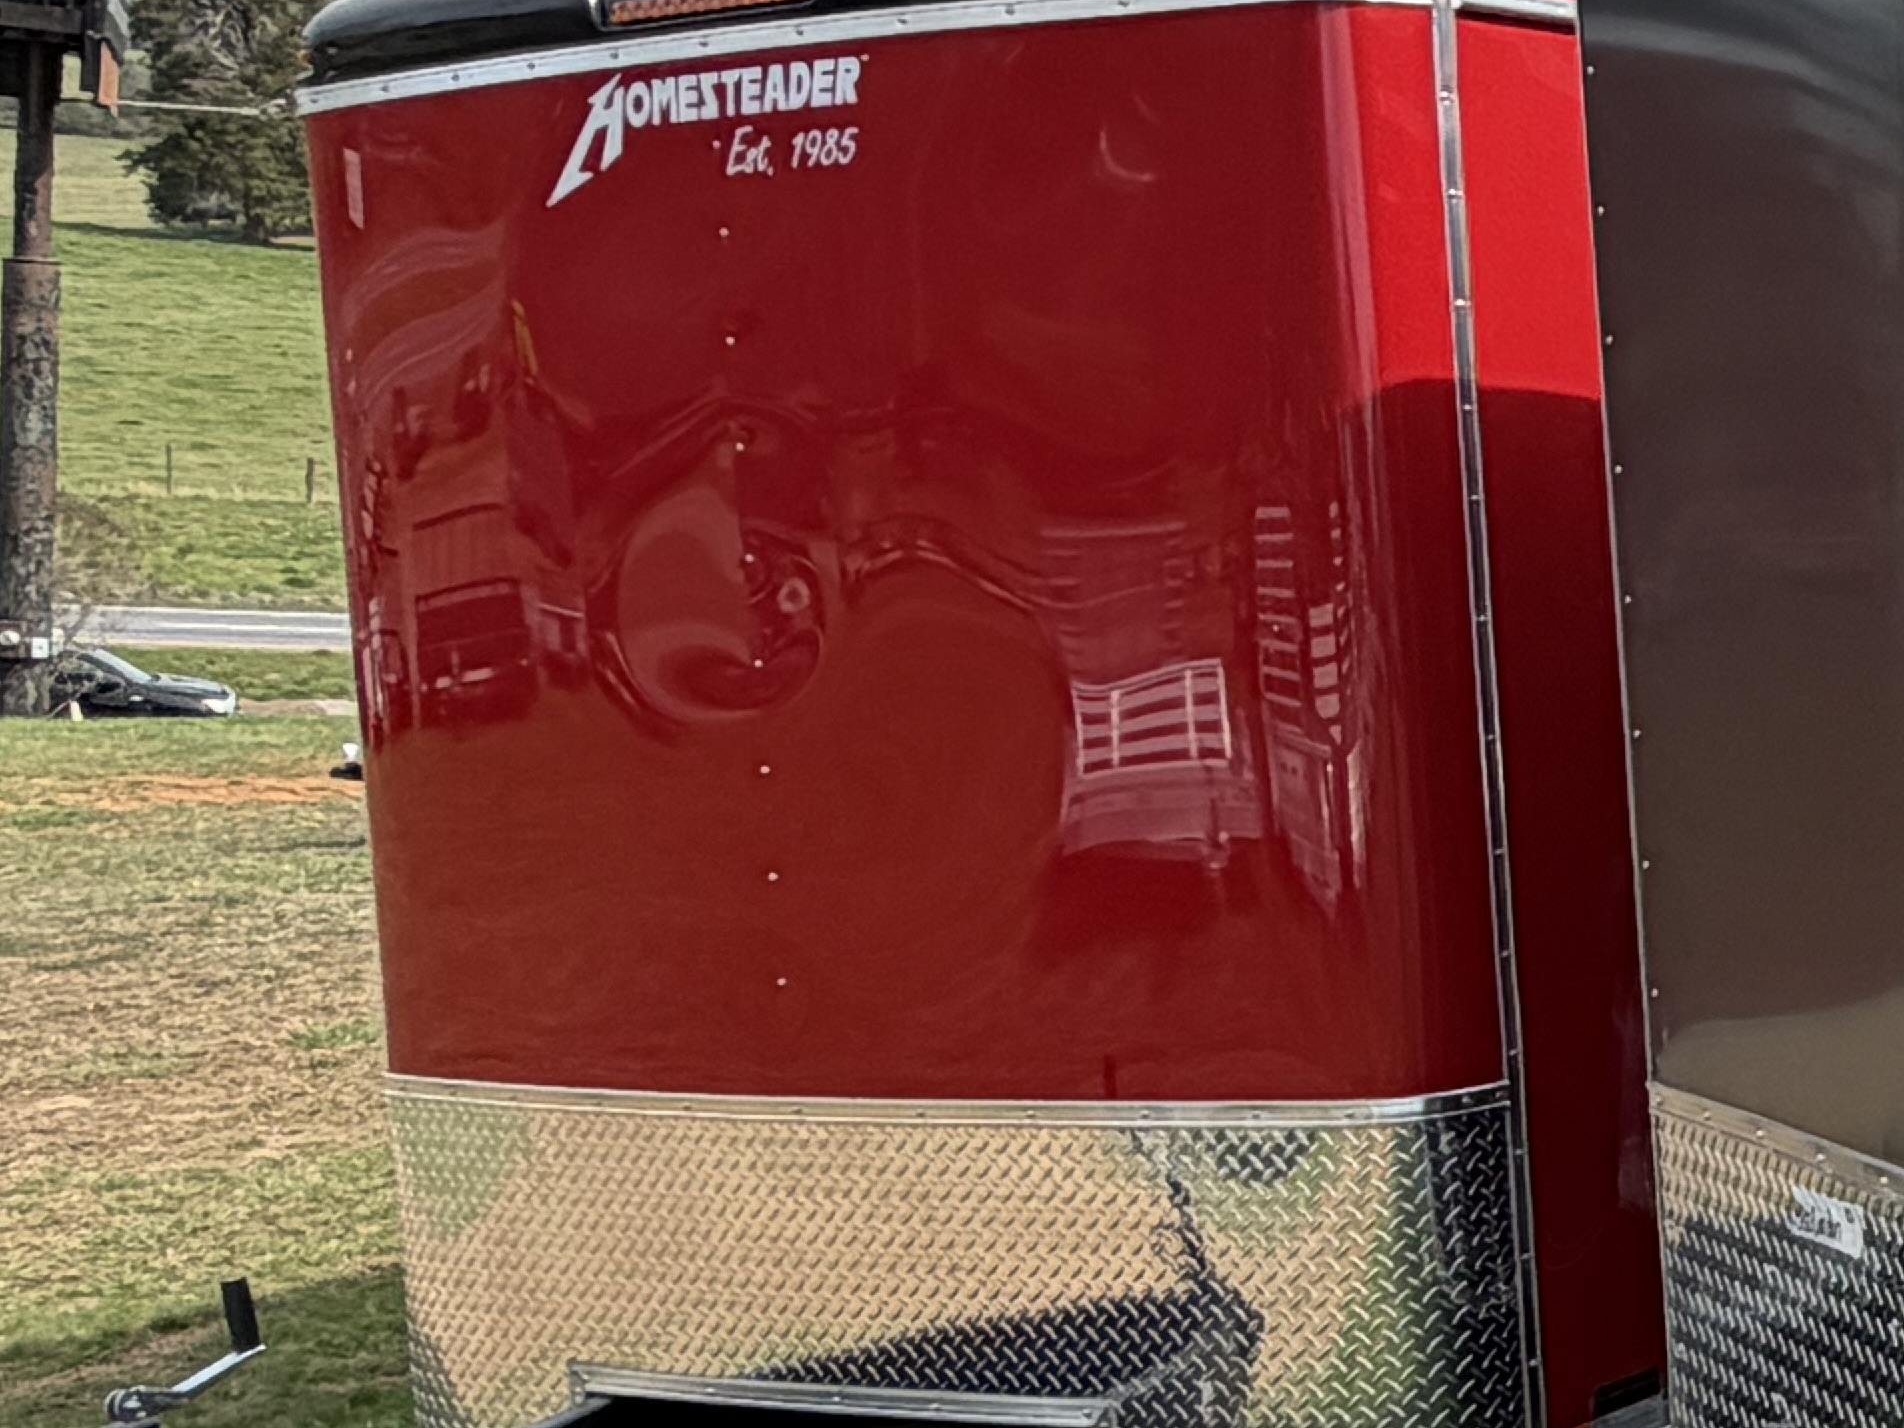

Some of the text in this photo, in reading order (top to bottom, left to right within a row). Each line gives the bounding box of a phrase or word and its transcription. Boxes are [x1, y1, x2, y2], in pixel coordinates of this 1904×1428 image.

[546, 56, 861, 208] HOMESTEADER
[726, 125, 860, 176] Est. 1985
